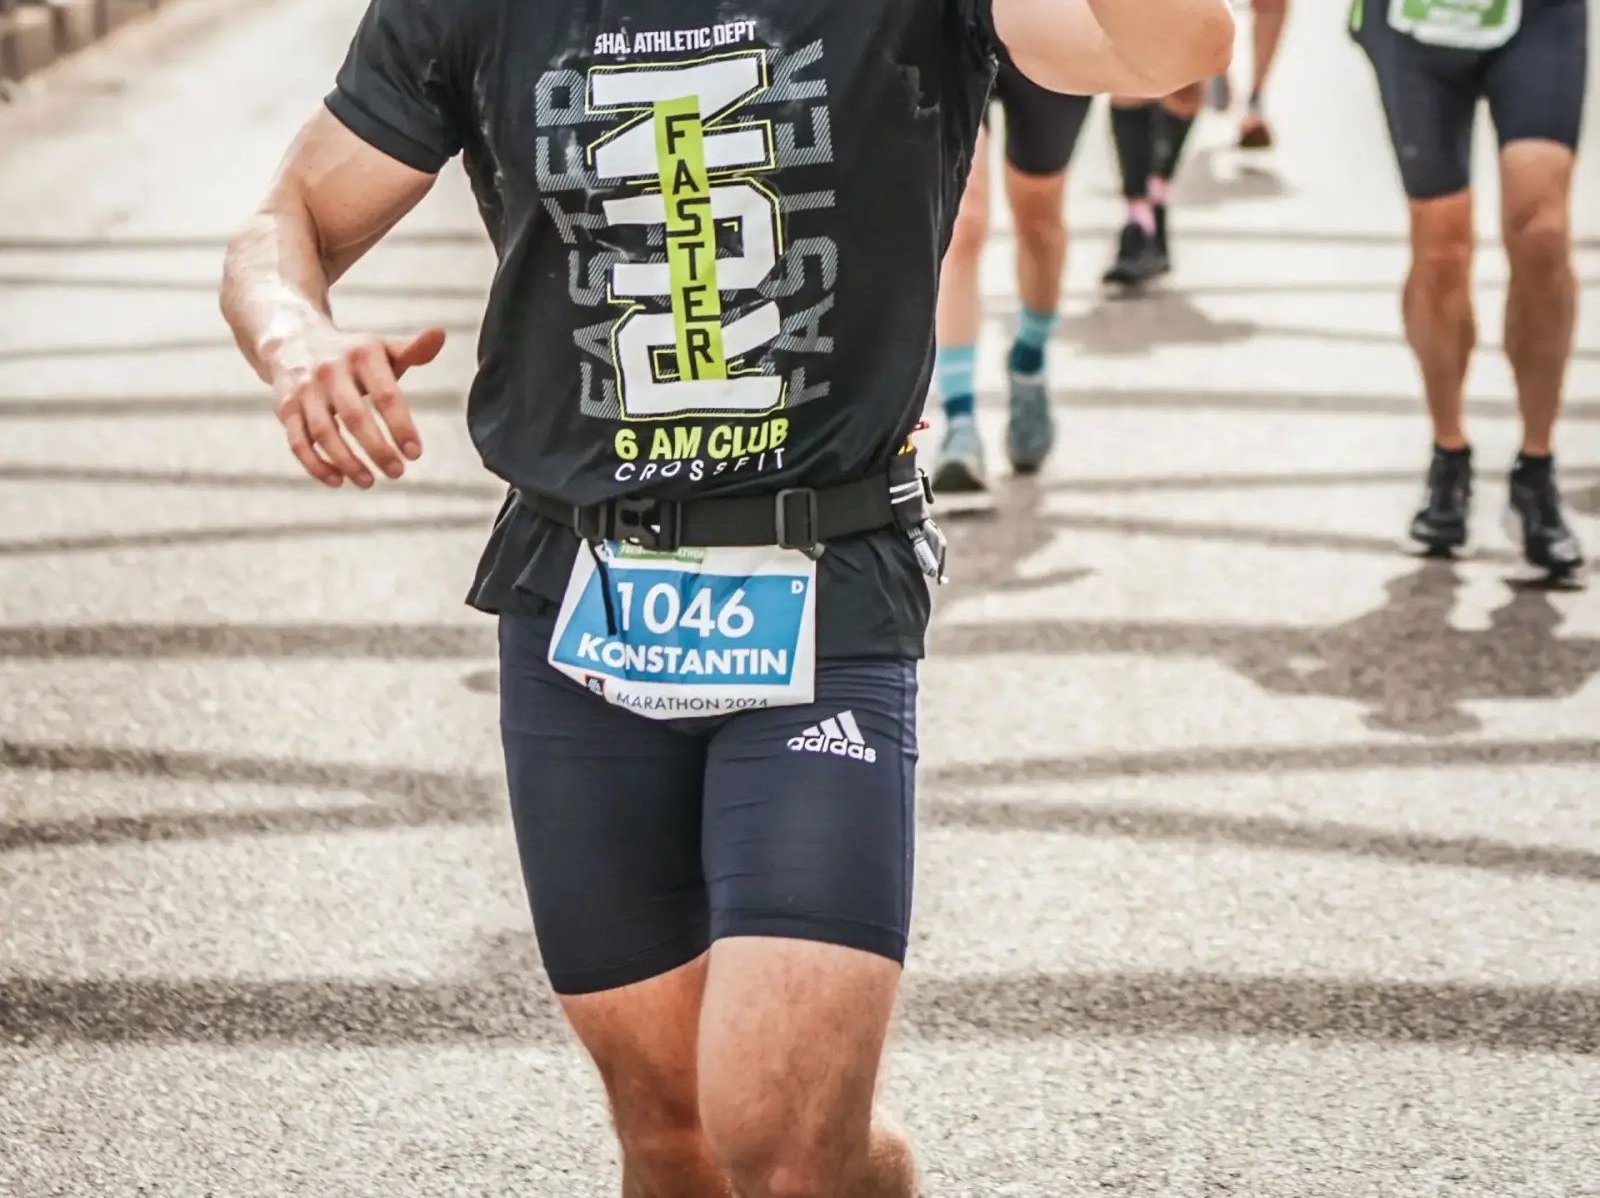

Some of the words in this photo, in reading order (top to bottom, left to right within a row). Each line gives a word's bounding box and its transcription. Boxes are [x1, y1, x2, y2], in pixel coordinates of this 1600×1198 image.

[593, 32, 632, 55] SHA.
[633, 27, 711, 54] ATHLETIC
[712, 20, 757, 46] DEPT
[664, 112, 713, 380] FASTER
[614, 428, 639, 460] 6
[648, 426, 703, 460] AM
[707, 417, 789, 460] CLUB
[614, 447, 786, 482] CROSSFIT
[791, 580, 805, 595] D
[616, 581, 755, 638] 1046
[577, 633, 788, 676] KONSTANTIN
[616, 692, 720, 711] MARATHON
[724, 697, 769, 710] 2024
[786, 734, 877, 763] adidas
